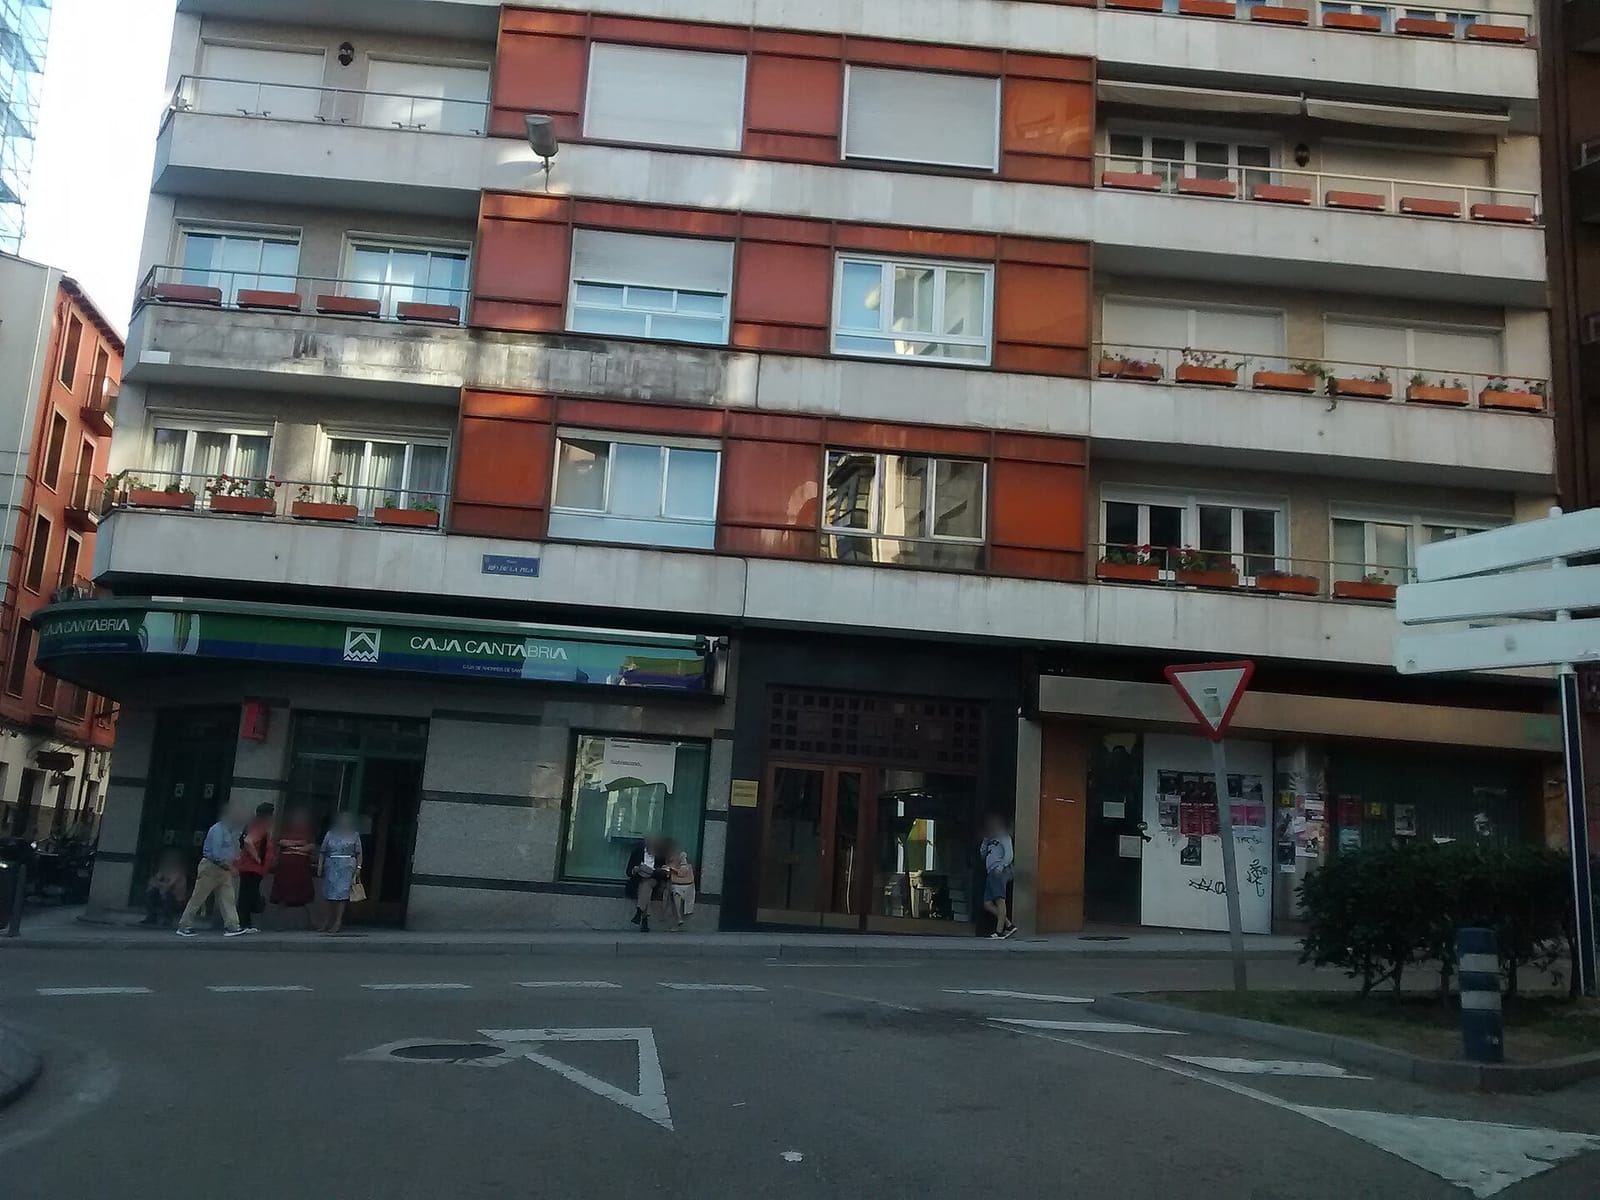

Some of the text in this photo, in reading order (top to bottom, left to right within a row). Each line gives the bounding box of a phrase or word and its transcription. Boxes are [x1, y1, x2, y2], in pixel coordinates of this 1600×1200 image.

[63, 618, 130, 634] CANTABRIA
[410, 636, 568, 661] CAJA CANTABRIA
